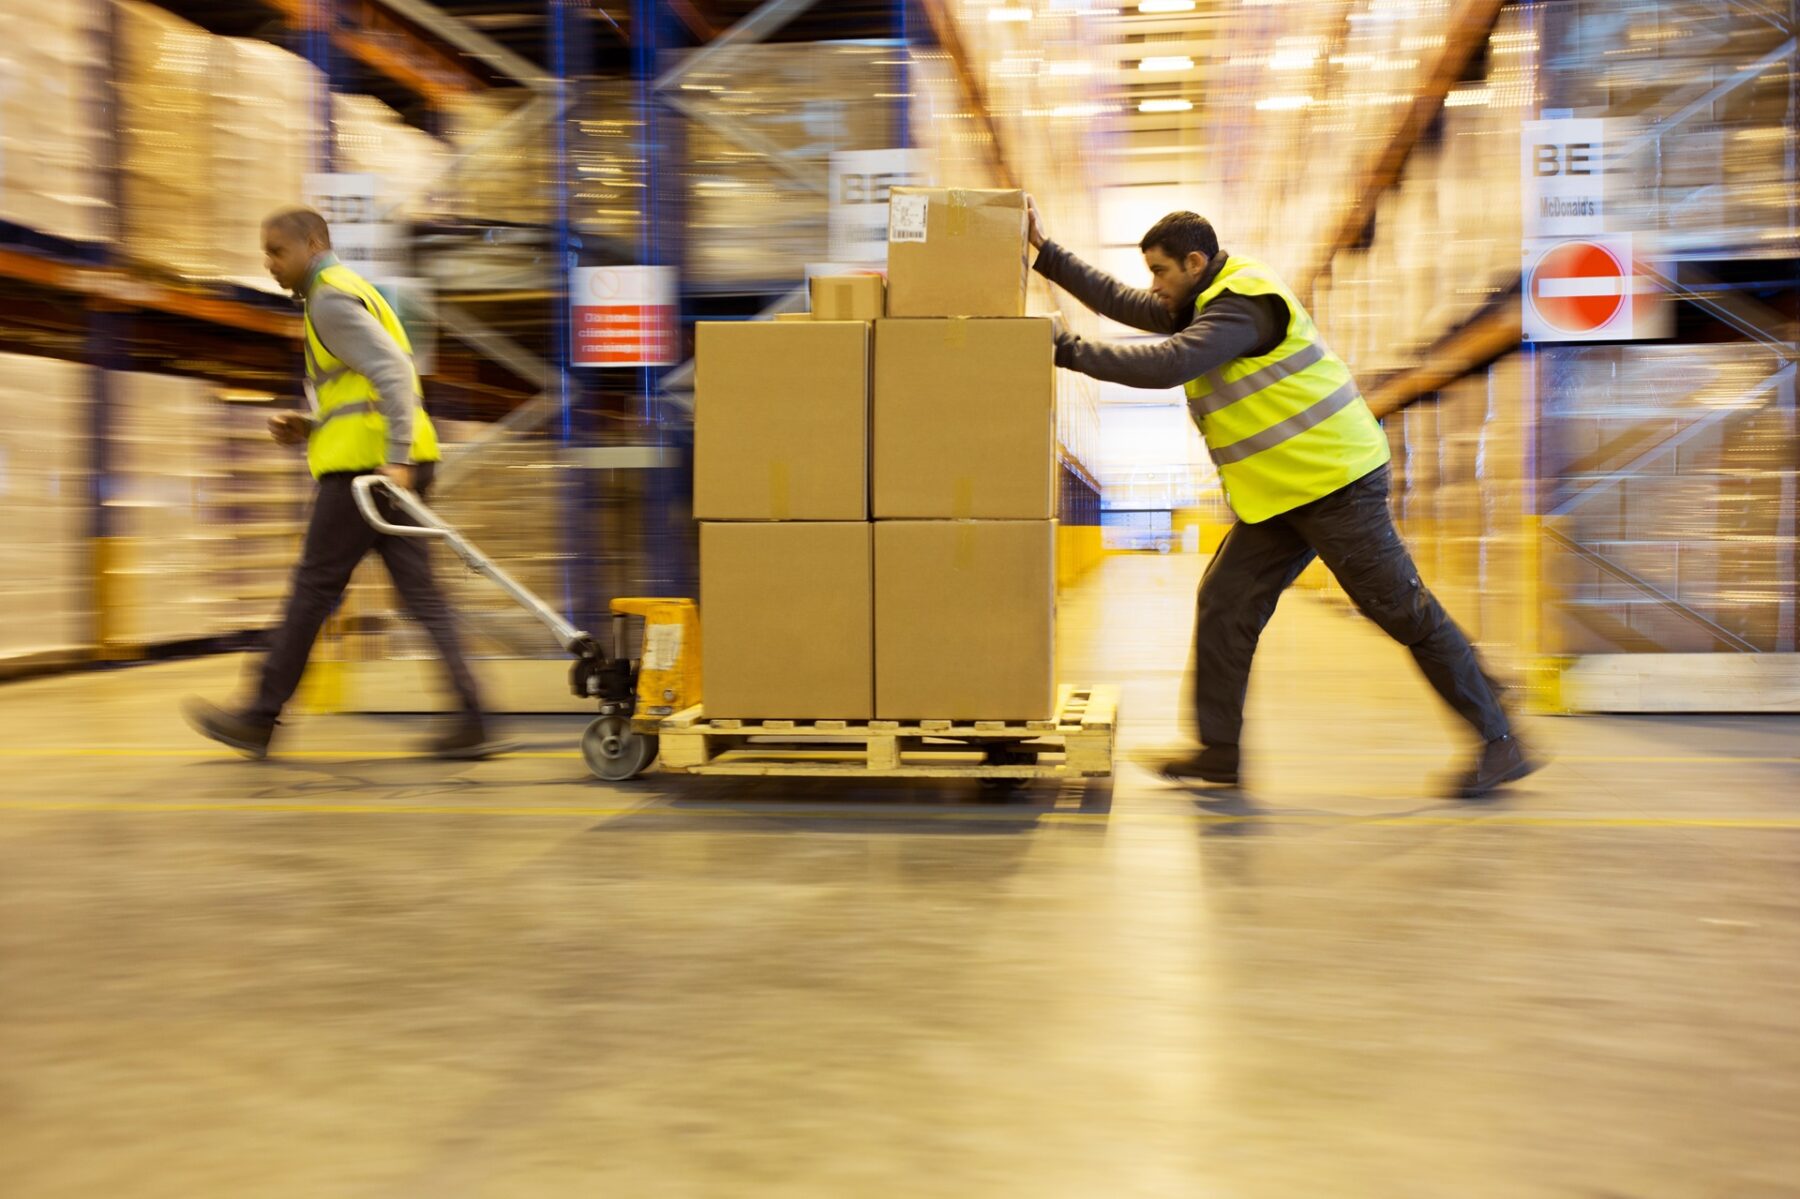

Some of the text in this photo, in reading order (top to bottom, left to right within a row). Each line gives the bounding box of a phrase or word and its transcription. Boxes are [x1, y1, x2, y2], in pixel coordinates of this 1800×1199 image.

[1533, 143, 1591, 176] BE
[841, 172, 893, 204] BE
[1540, 197, 1594, 217] McDonald's
